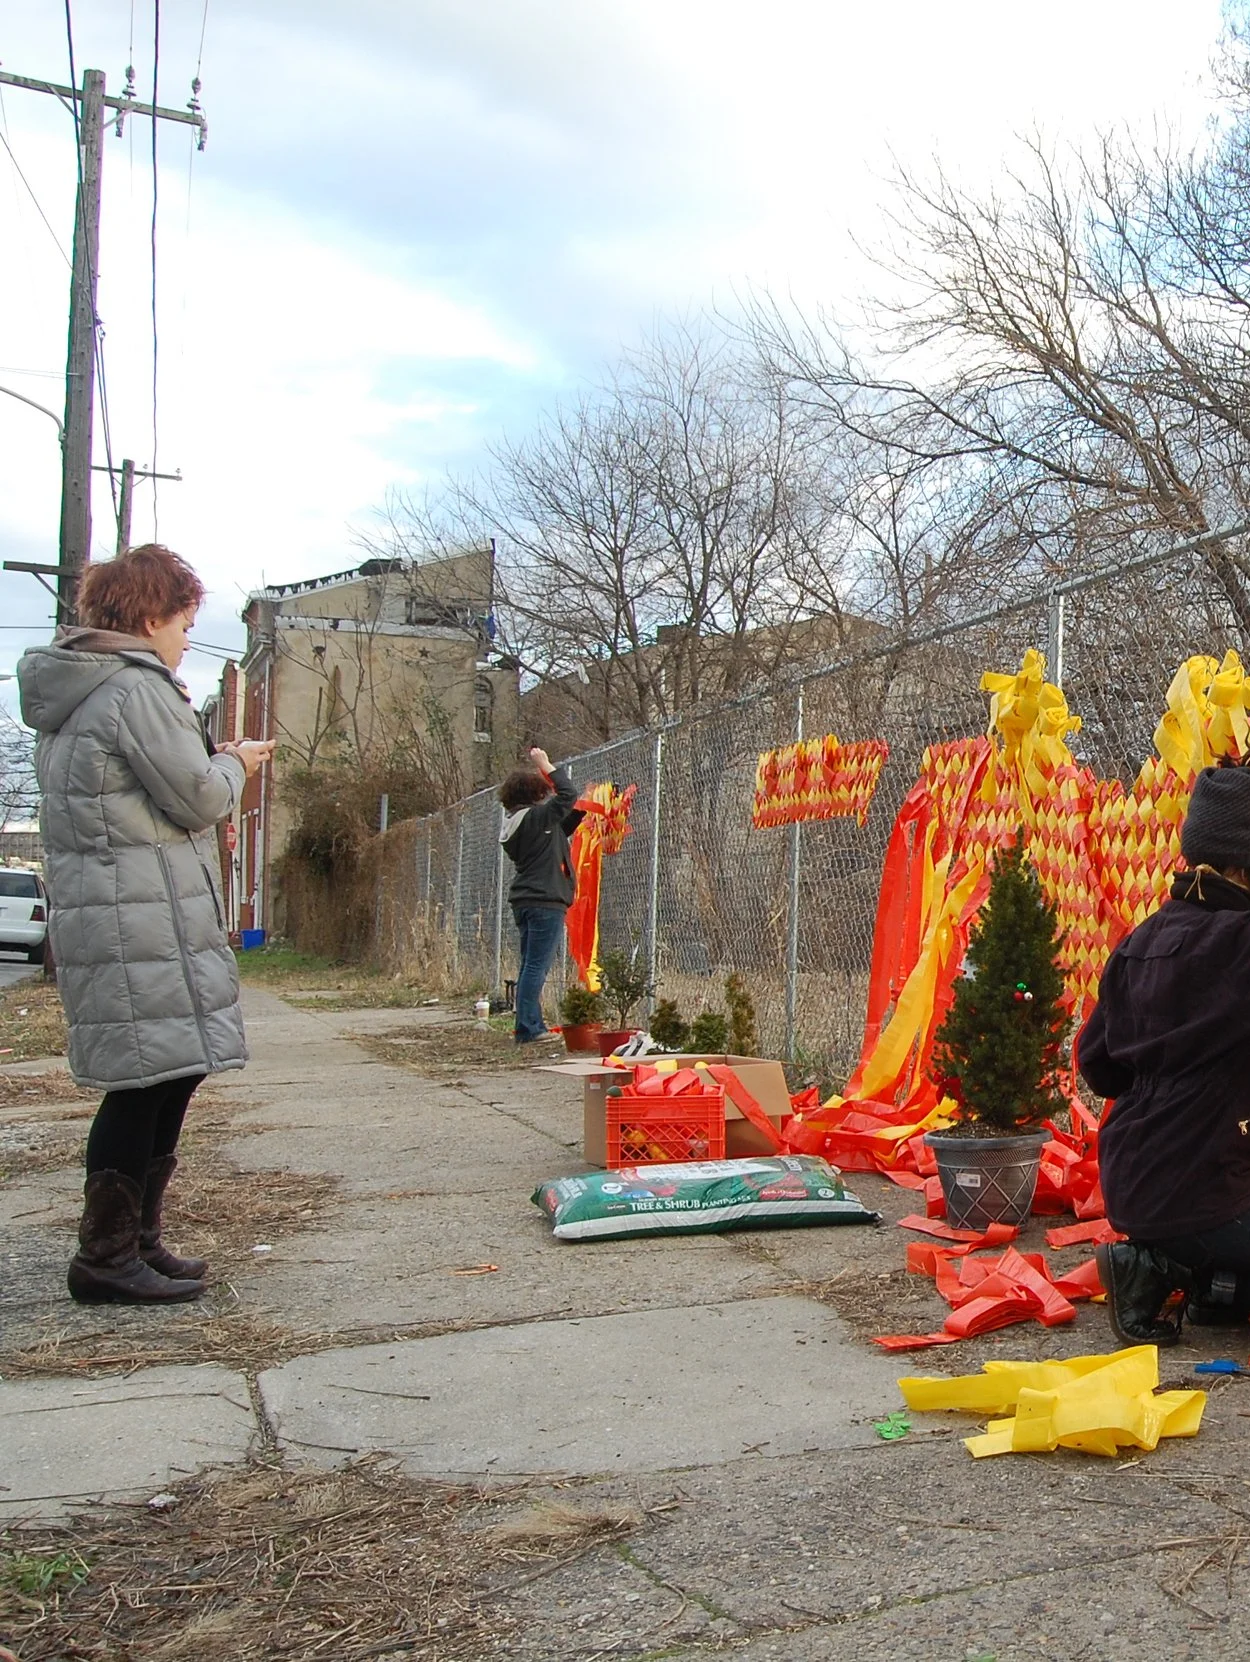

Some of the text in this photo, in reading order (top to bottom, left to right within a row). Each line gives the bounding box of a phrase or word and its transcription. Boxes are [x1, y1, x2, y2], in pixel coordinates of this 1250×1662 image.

[630, 1201, 655, 1211] TREE
[655, 1201, 663, 1210] &
[665, 1199, 701, 1210] SHRUB
